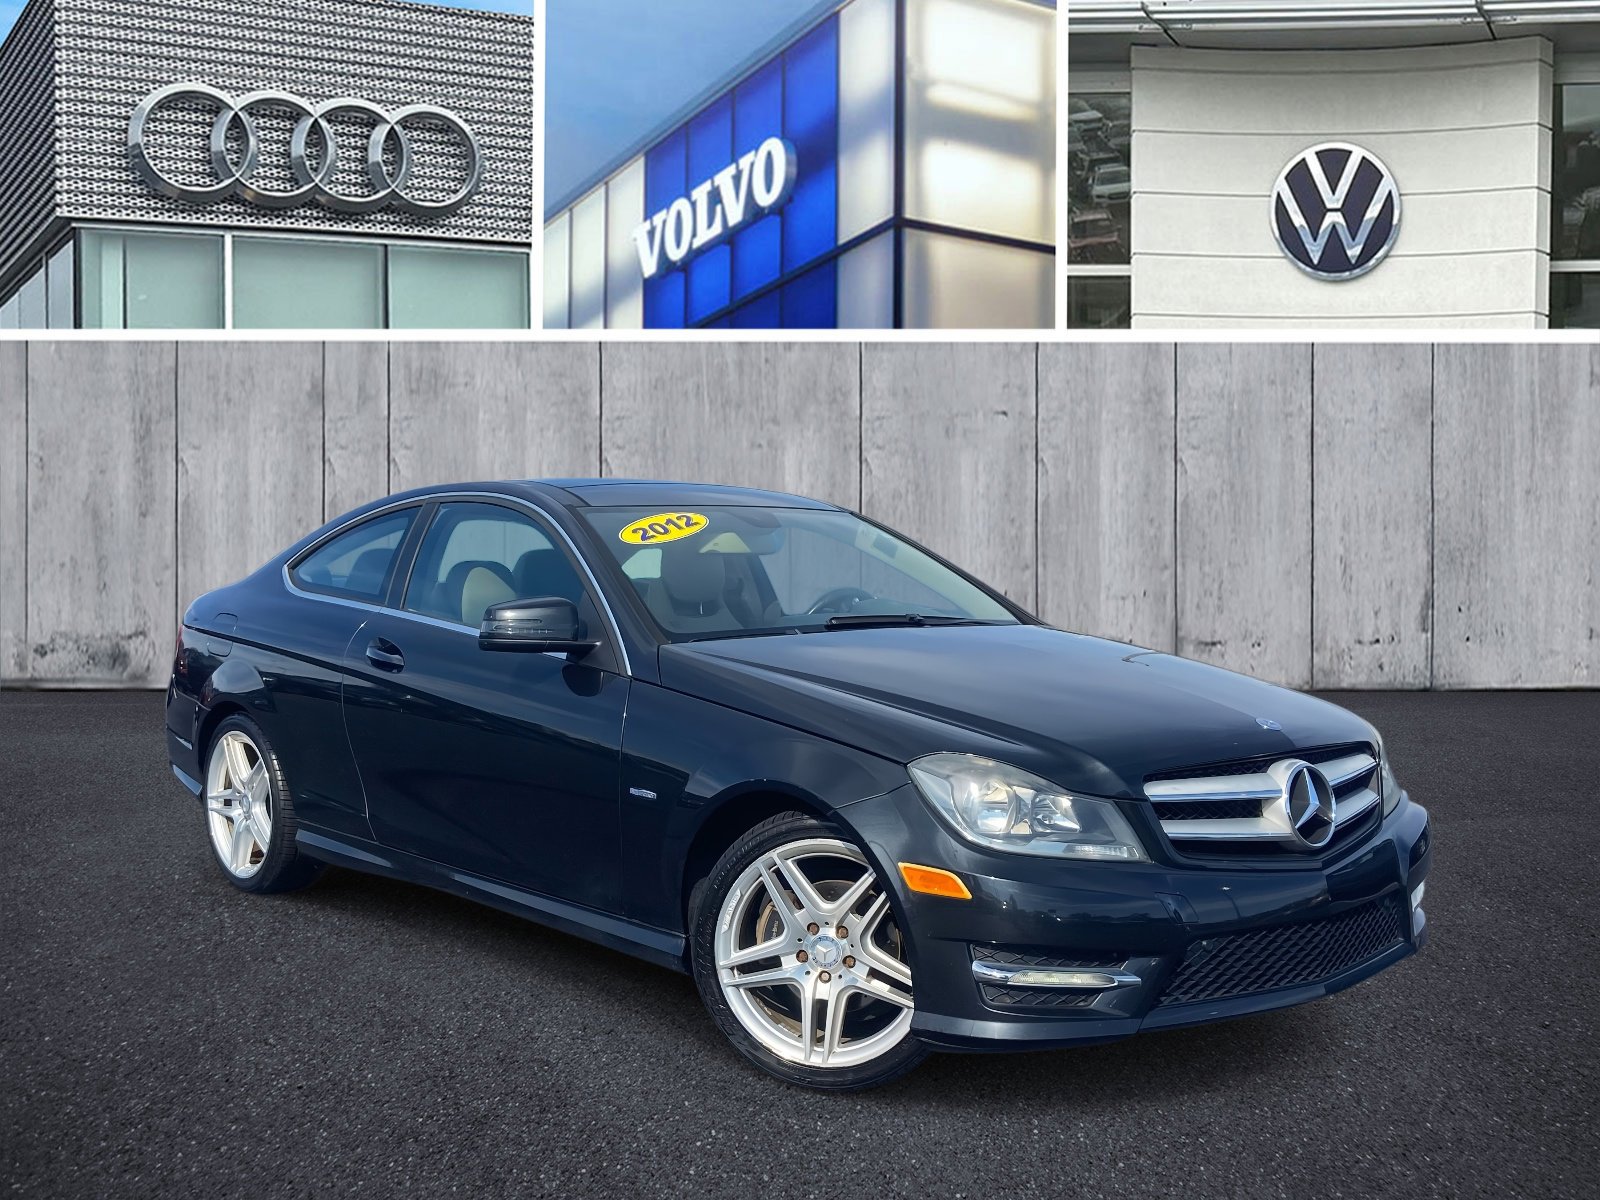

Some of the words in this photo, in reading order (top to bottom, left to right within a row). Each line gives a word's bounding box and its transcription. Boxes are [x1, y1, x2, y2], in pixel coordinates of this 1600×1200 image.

[632, 137, 787, 278] VOLVO
[1273, 144, 1397, 268] VW
[632, 515, 701, 541] 2012
